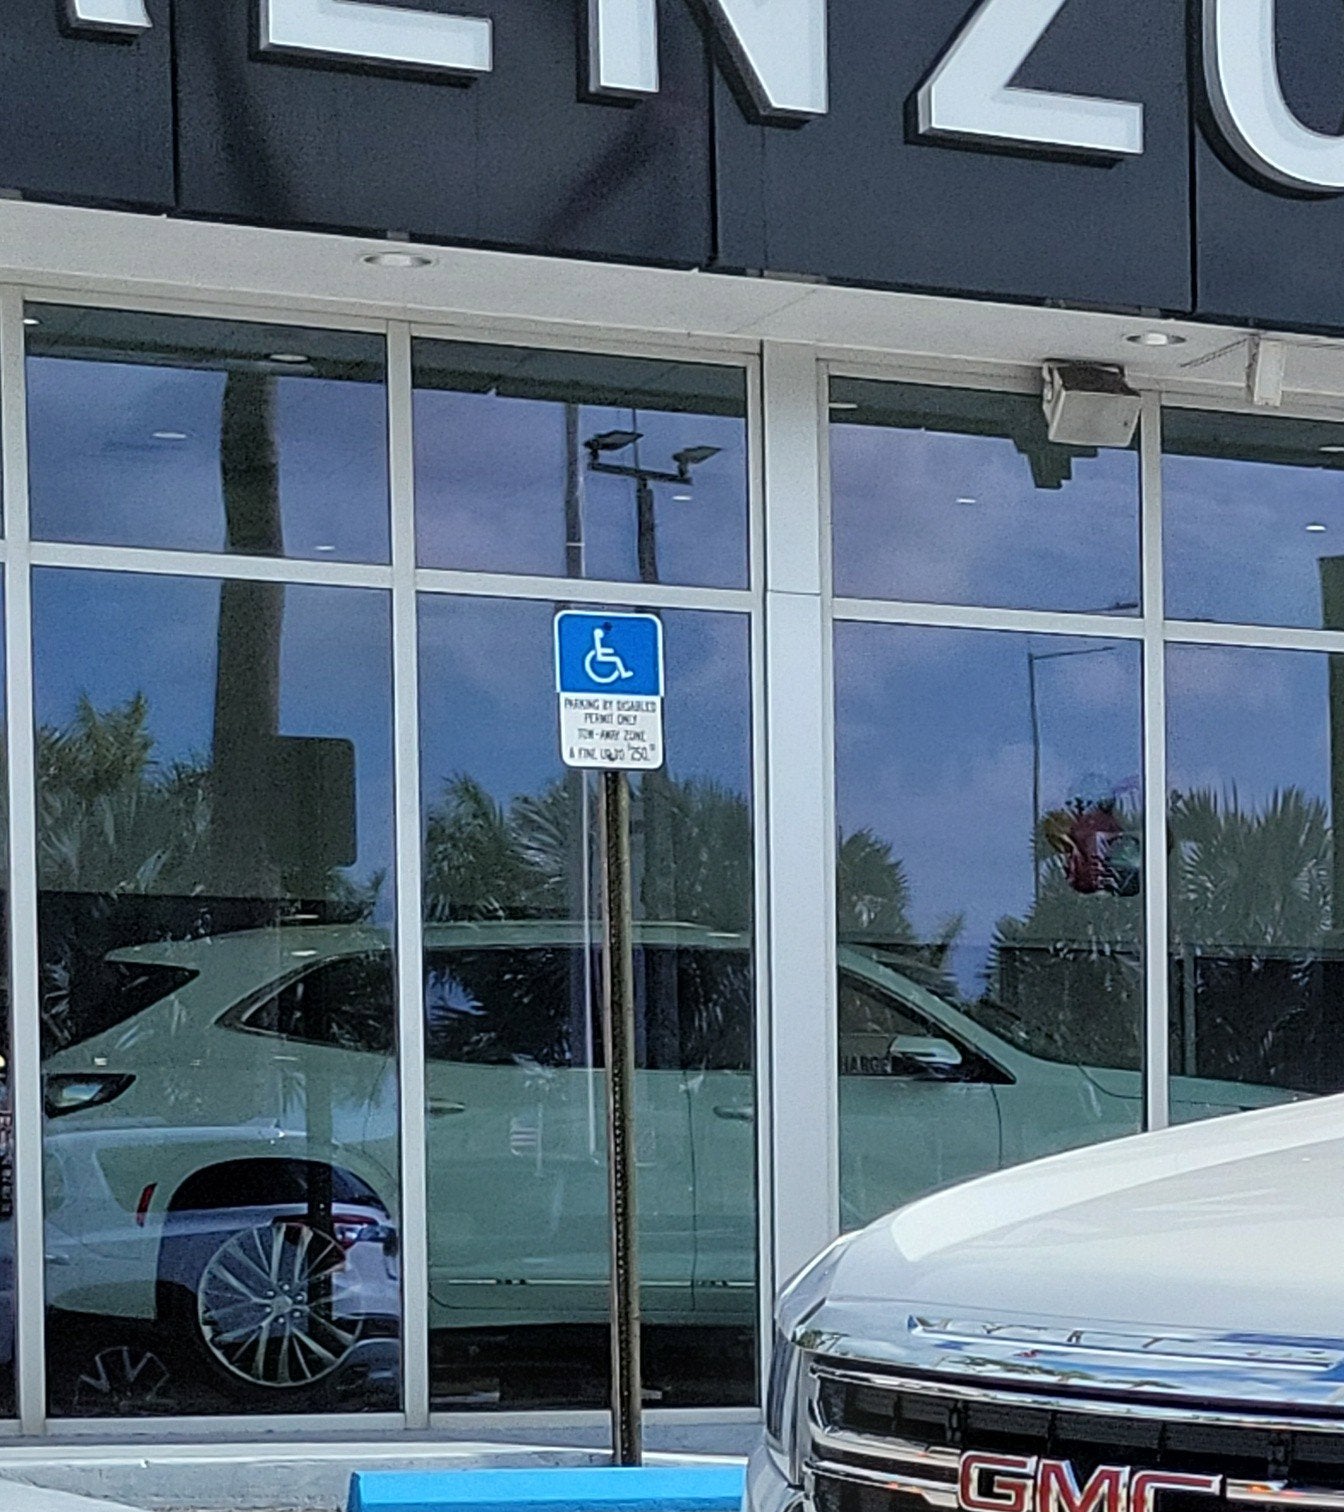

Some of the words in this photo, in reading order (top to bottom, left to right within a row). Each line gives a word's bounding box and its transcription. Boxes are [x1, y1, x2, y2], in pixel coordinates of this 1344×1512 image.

[564, 697, 600, 711] PARKING
[603, 699, 614, 711] BY
[617, 700, 657, 714] DISABLED
[584, 712, 614, 724] PERMIT
[617, 713, 638, 726] ONLY
[623, 729, 647, 742] ZONE
